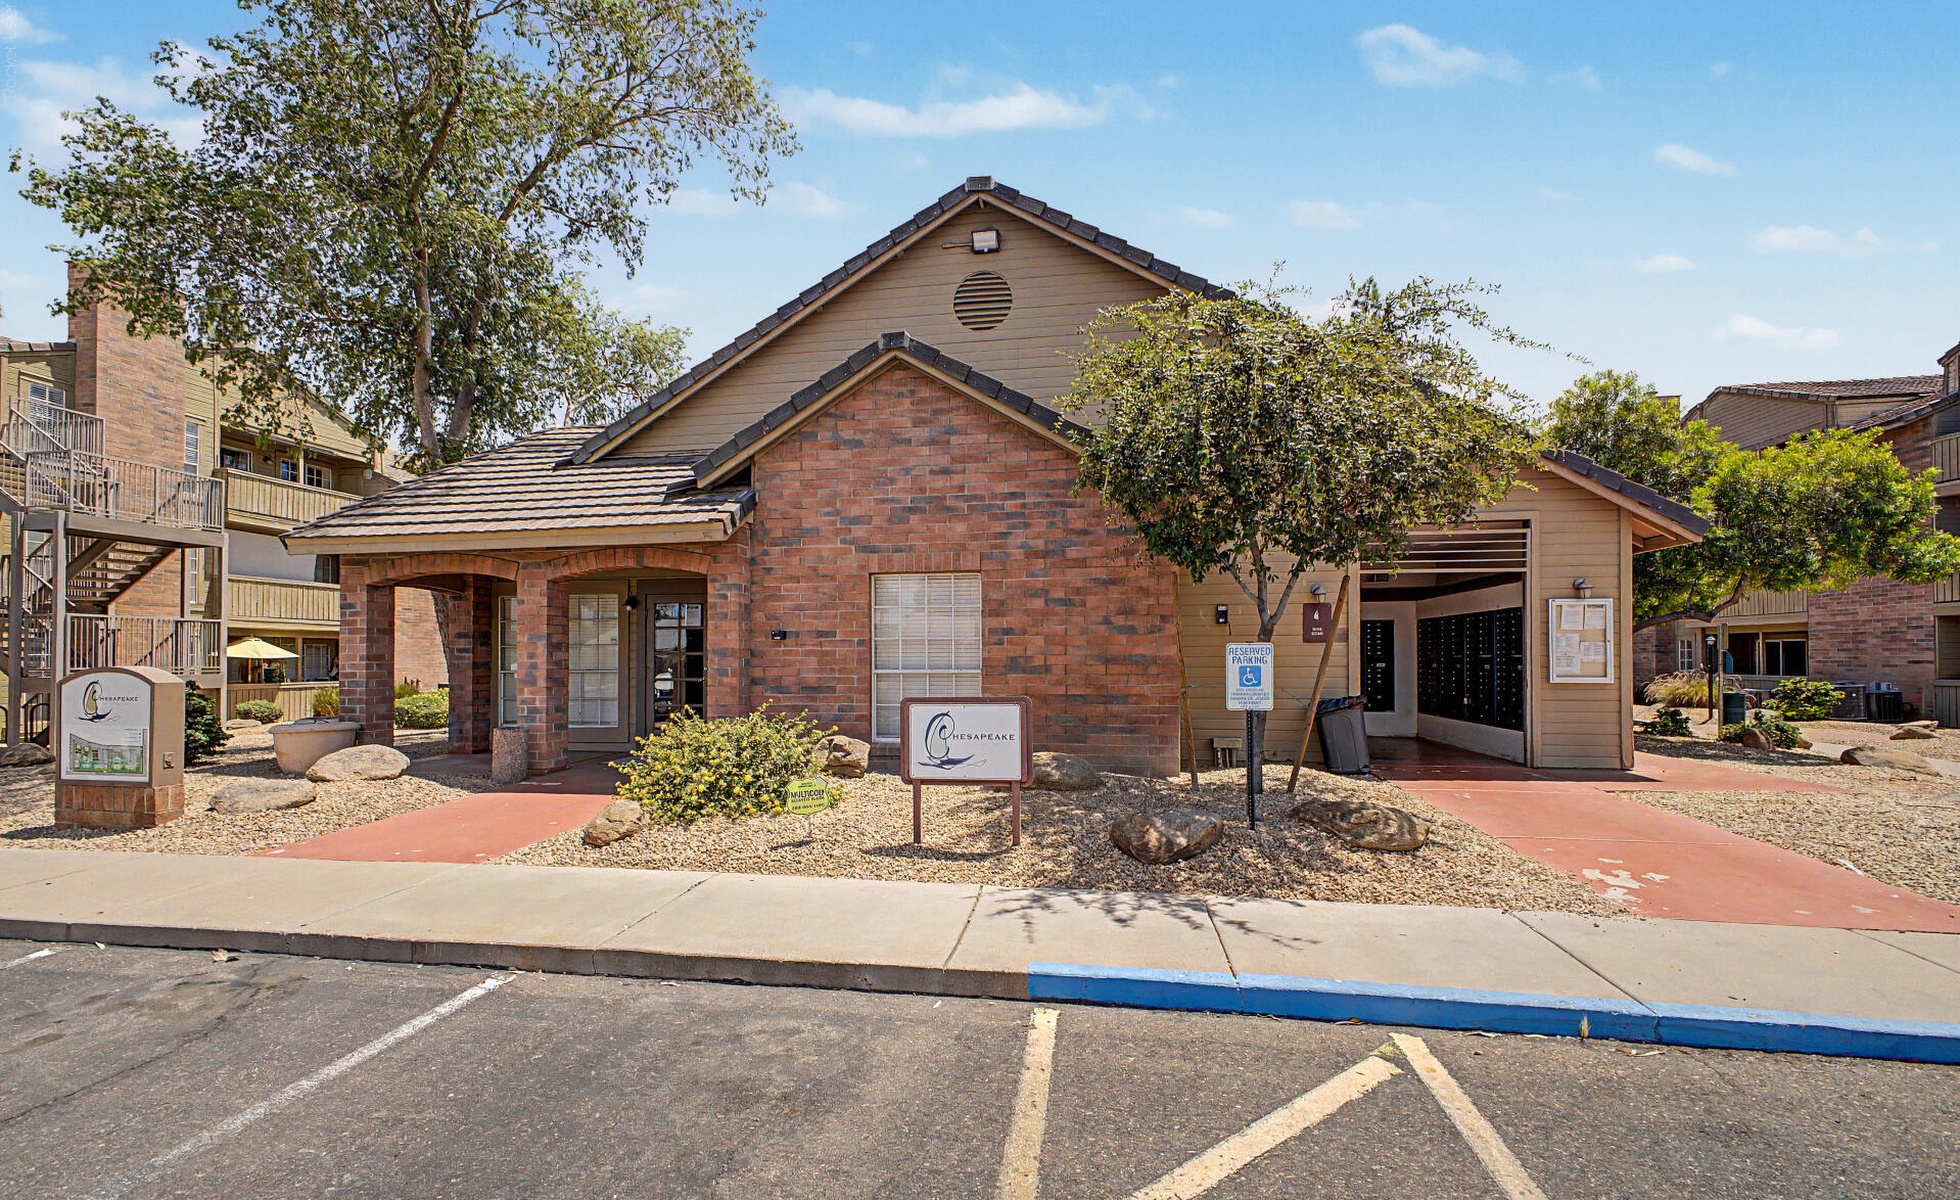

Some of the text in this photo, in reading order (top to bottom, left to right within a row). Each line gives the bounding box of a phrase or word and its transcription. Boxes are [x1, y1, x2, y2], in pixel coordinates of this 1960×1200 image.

[1228, 647, 1271, 656] RESERVED
[1231, 655, 1268, 665] PARKING
[925, 711, 1016, 759] CHESAPEAKE
